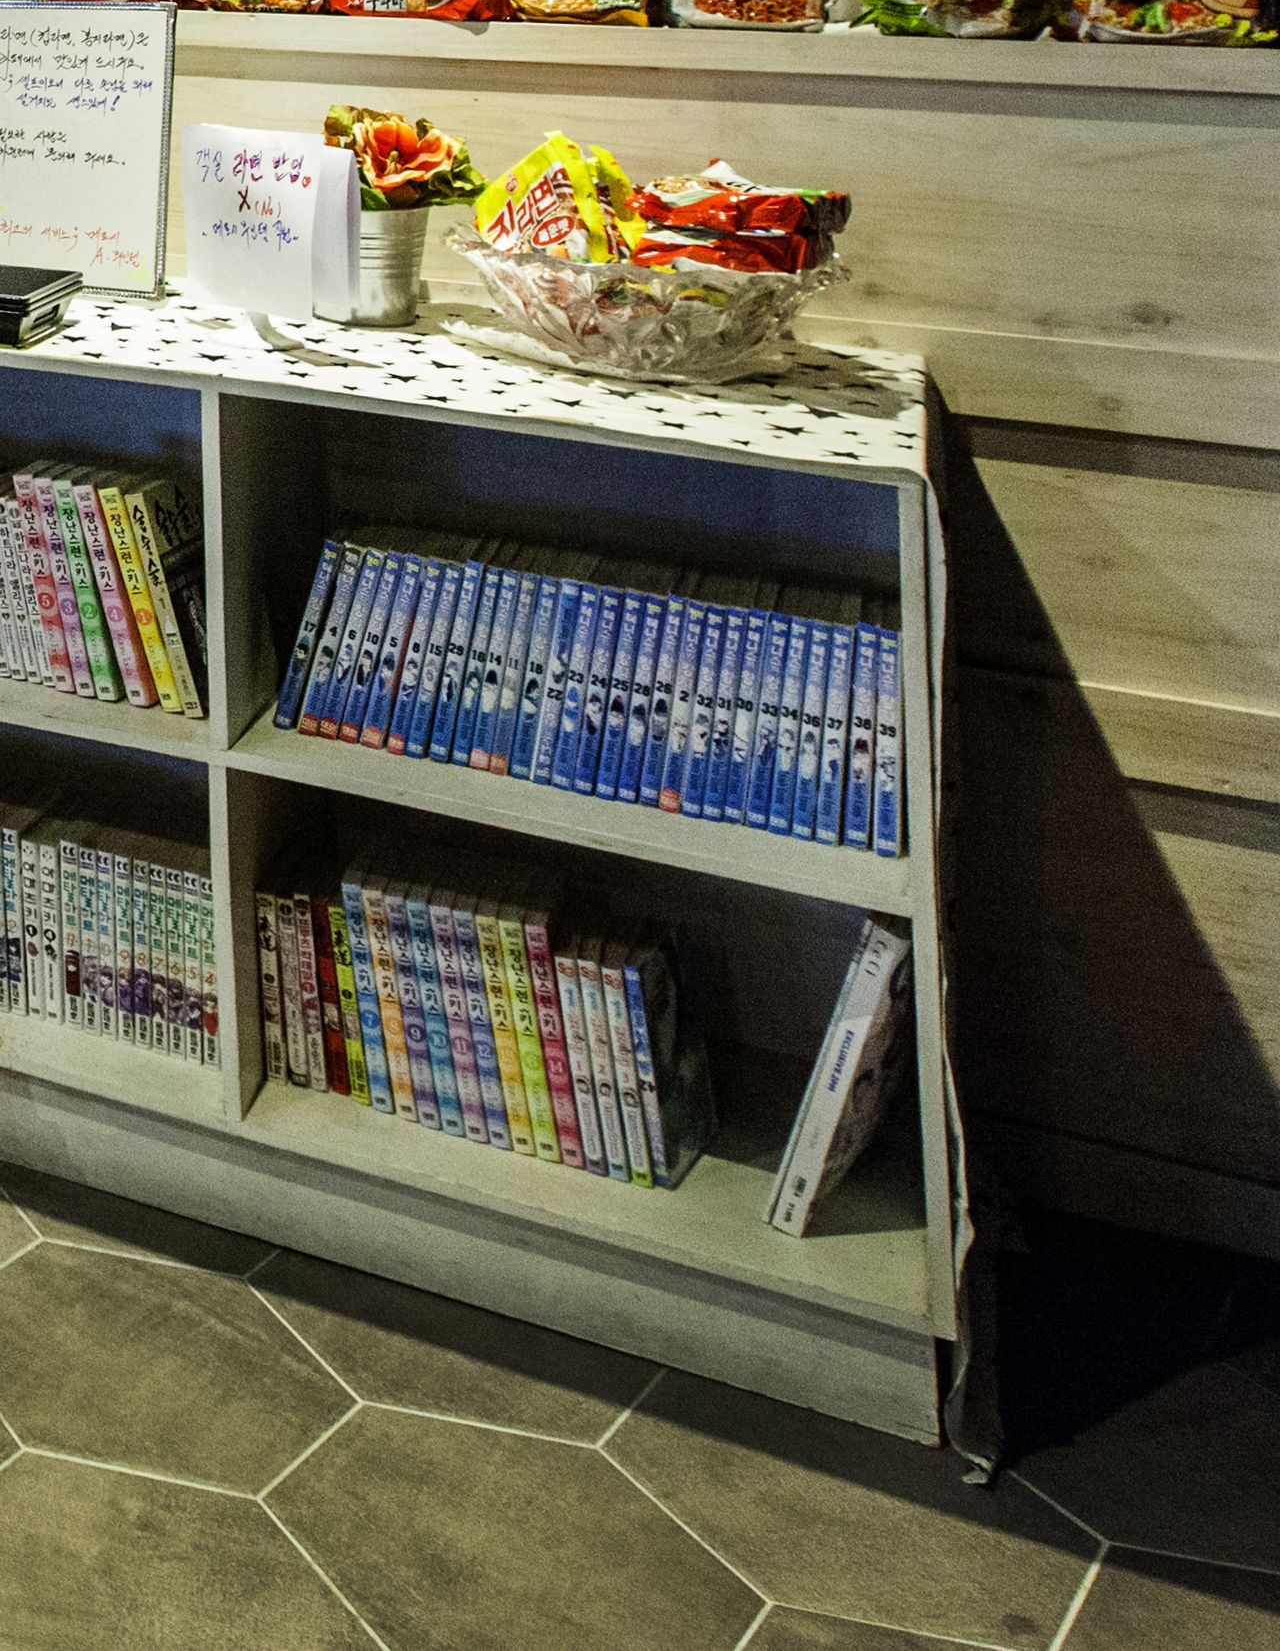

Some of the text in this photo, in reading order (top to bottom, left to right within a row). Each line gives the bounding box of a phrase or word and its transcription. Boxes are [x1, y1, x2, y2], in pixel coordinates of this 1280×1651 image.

[232, 149, 264, 184] 라면
[21, 500, 40, 549] 장난스런
[33, 553, 48, 580] 키스
[42, 505, 62, 554] 장난스런
[55, 559, 71, 586] 키스
[61, 507, 82, 558] 장난스런
[75, 563, 90, 589] 키스
[83, 511, 107, 561] 장난스런
[99, 565, 116, 592] 키스
[109, 513, 133, 564] 장난스런
[127, 568, 143, 596] 키스
[329, 626, 338, 637] 4
[366, 632, 379, 645] 10
[389, 637, 398, 648] 5
